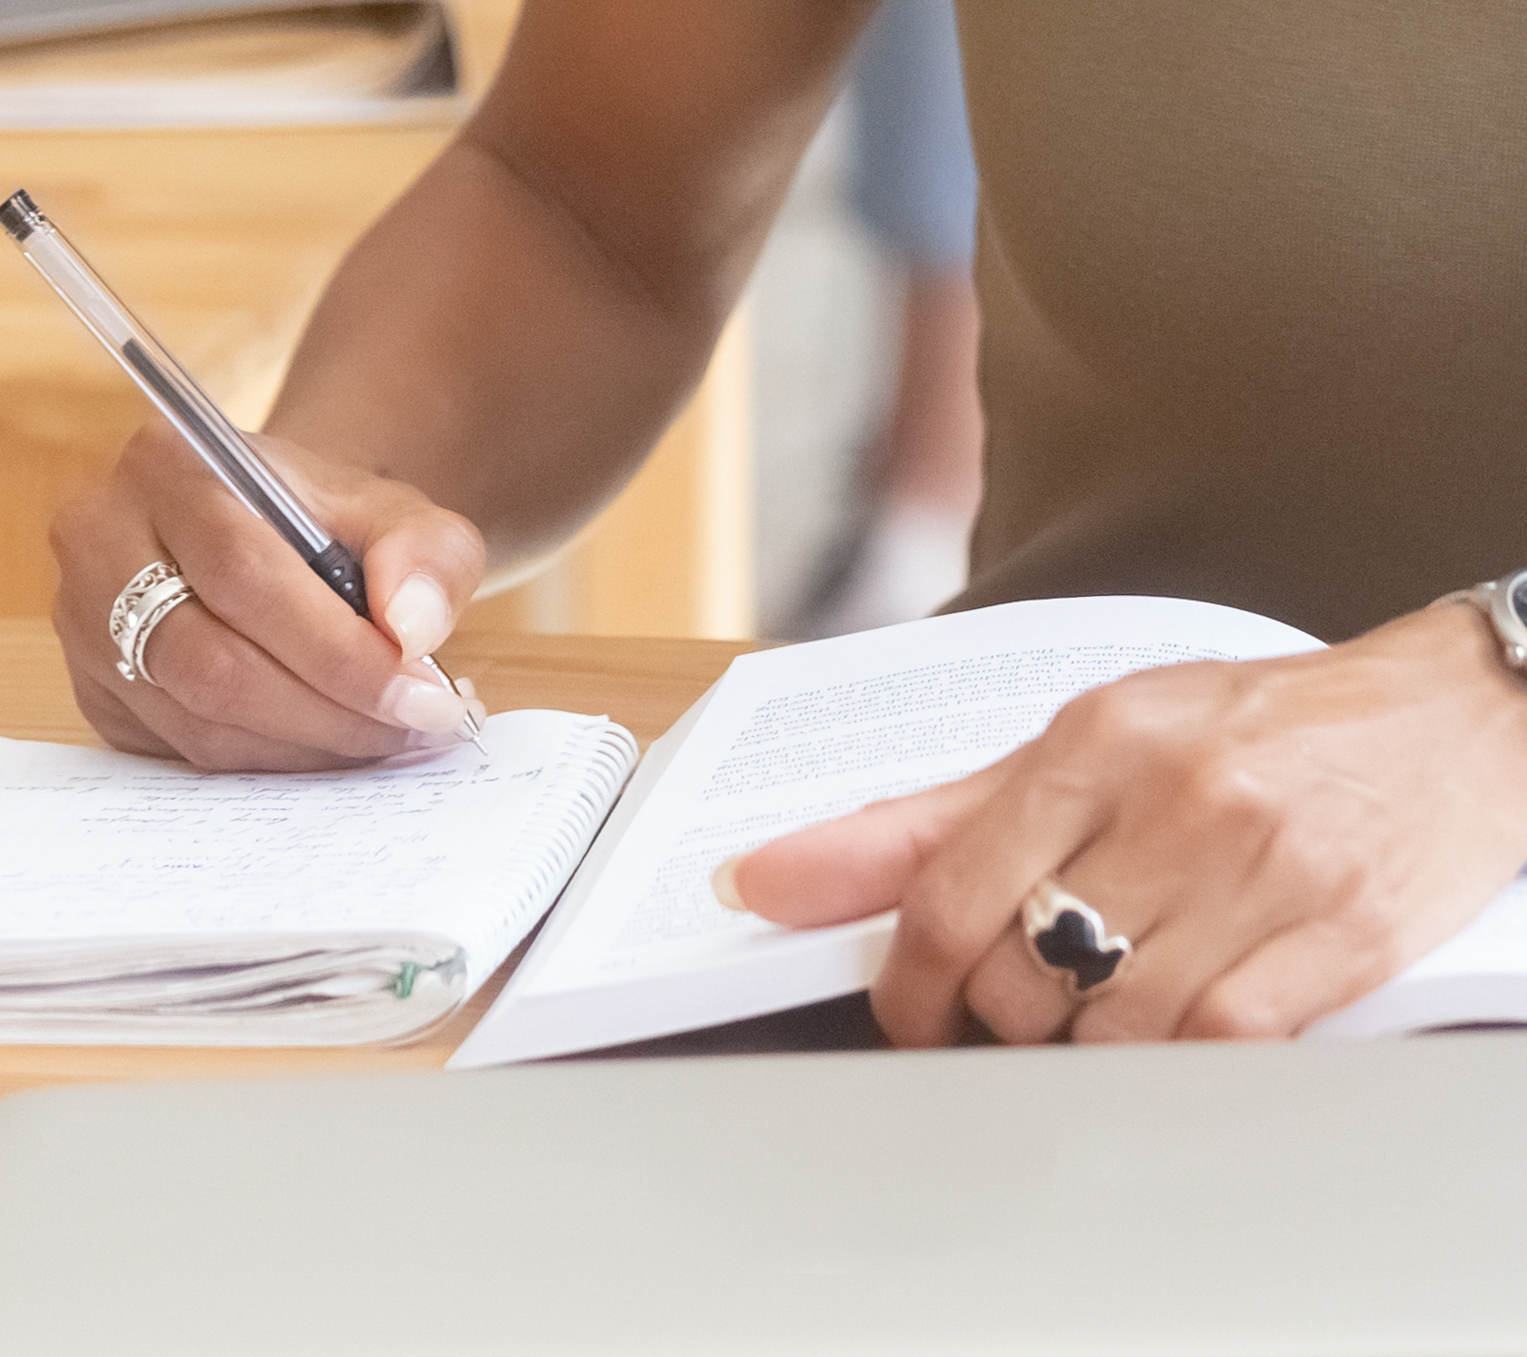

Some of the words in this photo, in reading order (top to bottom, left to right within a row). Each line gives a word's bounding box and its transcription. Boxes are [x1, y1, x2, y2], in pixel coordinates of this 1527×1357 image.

[979, 651, 1017, 661] data
[848, 660, 955, 688] summarized
[900, 661, 991, 682] employees
[948, 660, 1061, 679] development
[948, 671, 1019, 685] findings
[986, 675, 1040, 686] higher
[859, 676, 939, 697] strategies
[862, 679, 894, 691] and
[890, 682, 943, 697] clearly
[938, 682, 978, 695] level
[970, 684, 1018, 695] talent
[794, 688, 820, 699] the
[884, 694, 913, 704] job
[754, 694, 824, 713] meeting
[838, 695, 880, 708] show
[854, 691, 964, 717] development
[955, 695, 989, 705] and
[784, 702, 818, 713] also
[797, 706, 830, 717] that
[749, 711, 776, 720] the
[938, 711, 970, 722] and
[739, 724, 773, 736] and
[911, 722, 944, 732] that
[820, 732, 887, 751] focused
[975, 740, 1009, 749] that
[836, 742, 945, 766] Implications
[715, 752, 789, 771] building
[710, 768, 743, 780] and
[748, 773, 808, 792] people
